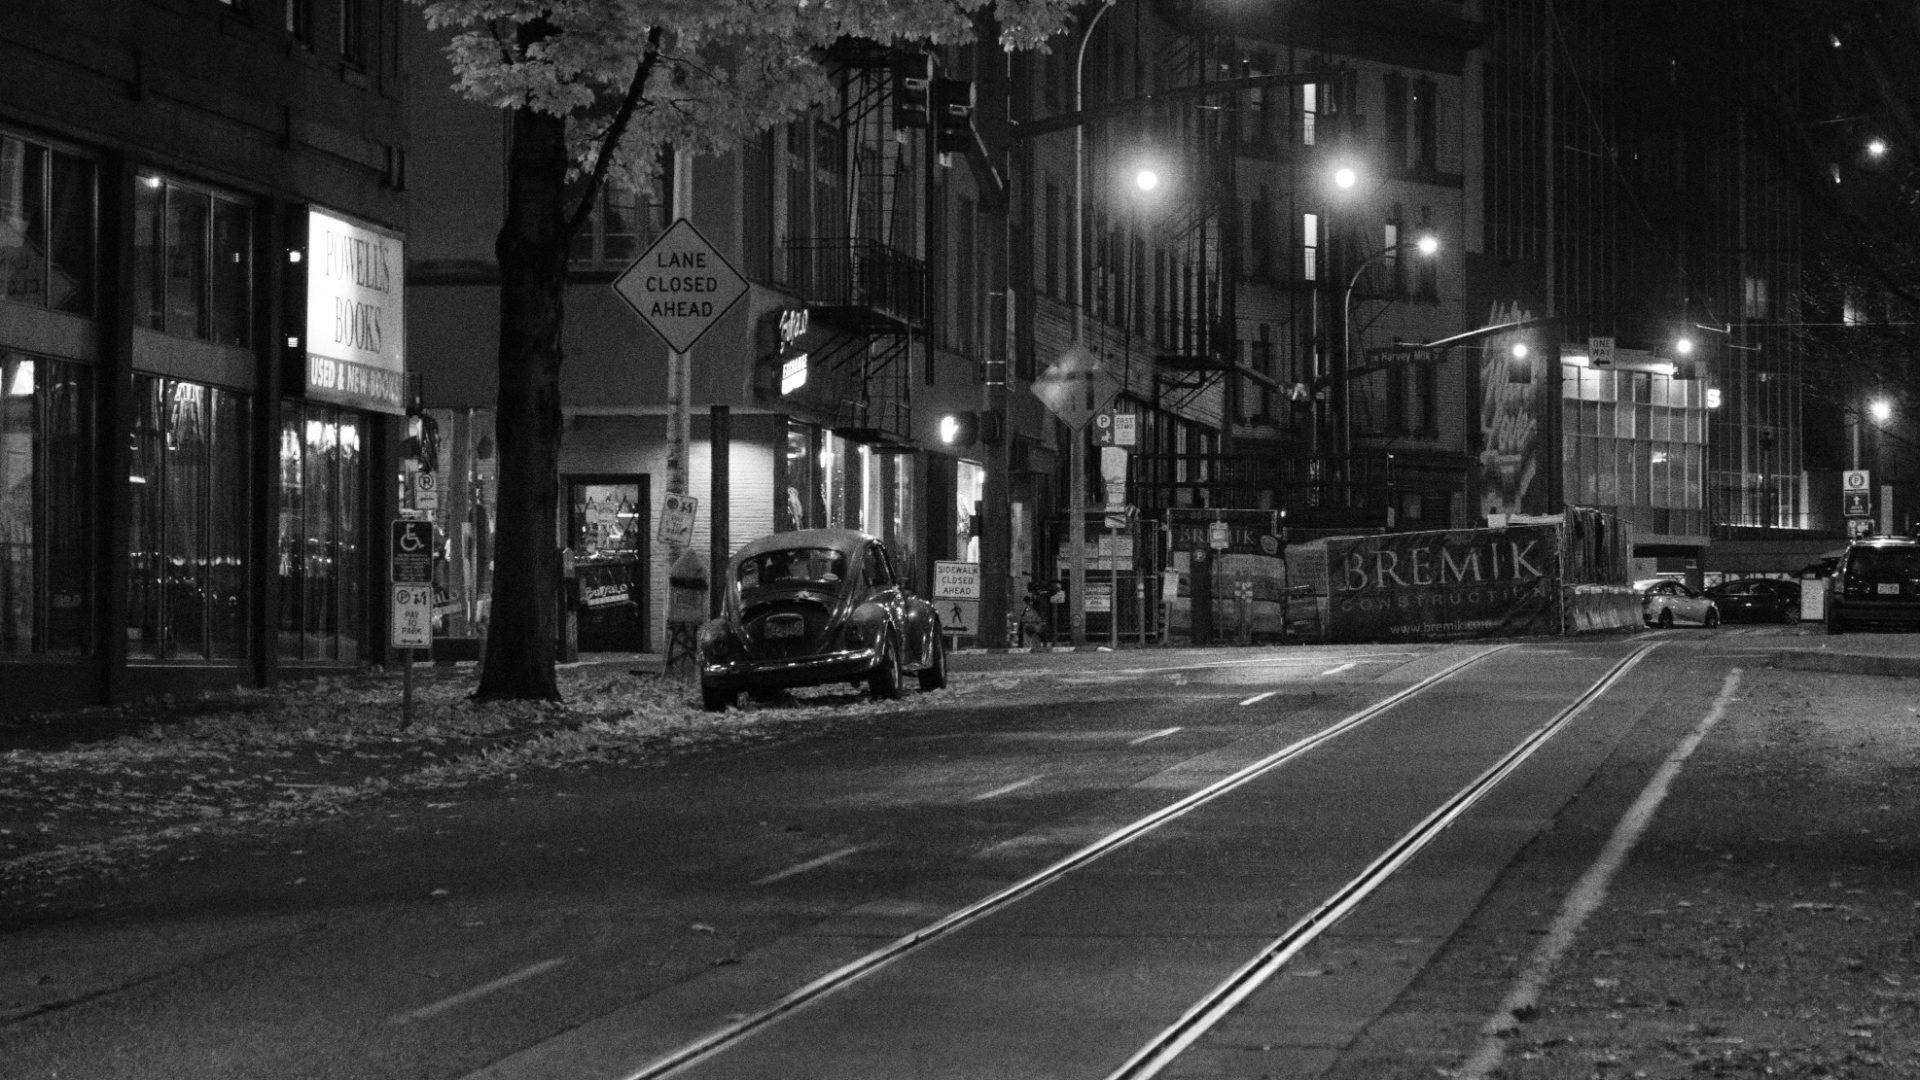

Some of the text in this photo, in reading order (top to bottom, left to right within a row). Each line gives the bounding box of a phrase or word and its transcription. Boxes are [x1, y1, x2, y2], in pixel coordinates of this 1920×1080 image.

[325, 230, 389, 293] POWELL'S
[657, 252, 706, 268] LANE
[646, 276, 717, 292] CLOSED
[651, 301, 713, 317] AHEAD
[334, 297, 382, 354] BOOKS
[1592, 348, 1610, 356] WAY
[1593, 340, 1610, 348] ONE
[311, 357, 335, 388] USED
[337, 363, 345, 390] &
[347, 364, 368, 395] NEW
[938, 566, 979, 575] SIDEWALK
[1338, 540, 1544, 592] BREMIK
[941, 576, 974, 585] CLOSED
[943, 587, 972, 595] AHEAD
